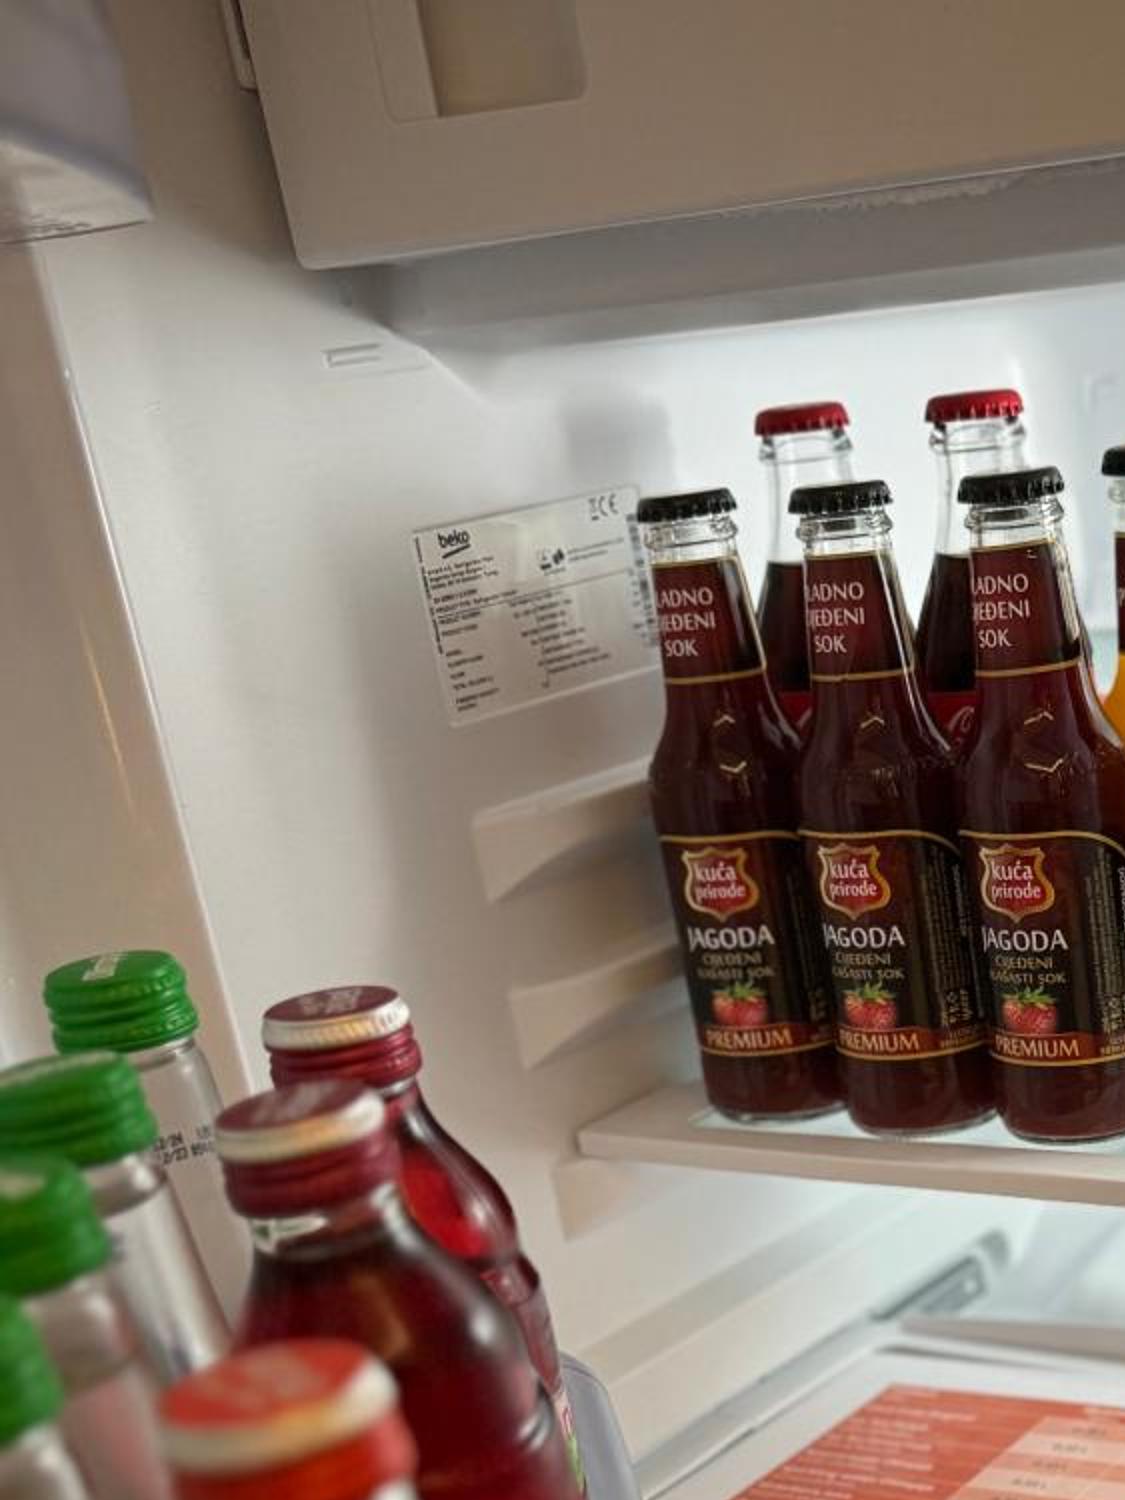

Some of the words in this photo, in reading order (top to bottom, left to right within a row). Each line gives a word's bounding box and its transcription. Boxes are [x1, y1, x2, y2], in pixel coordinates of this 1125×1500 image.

[438, 529, 470, 548] beko
[665, 639, 698, 657] SOK
[814, 635, 847, 654] SOK
[979, 629, 1013, 649] SOK
[695, 861, 737, 882] kuća
[829, 858, 869, 880] kuća
[991, 859, 1033, 881] kuća
[694, 884, 746, 903] prirode
[829, 880, 878, 899] prirode
[991, 880, 1042, 902] prirode
[687, 924, 775, 952] JAGODA
[822, 924, 906, 949] JAGODA
[982, 926, 1069, 953] JAGODA
[705, 1029, 792, 1050] PREMIUM
[839, 1029, 920, 1051] PREMIUM
[994, 1034, 1081, 1057] PREMIUM
